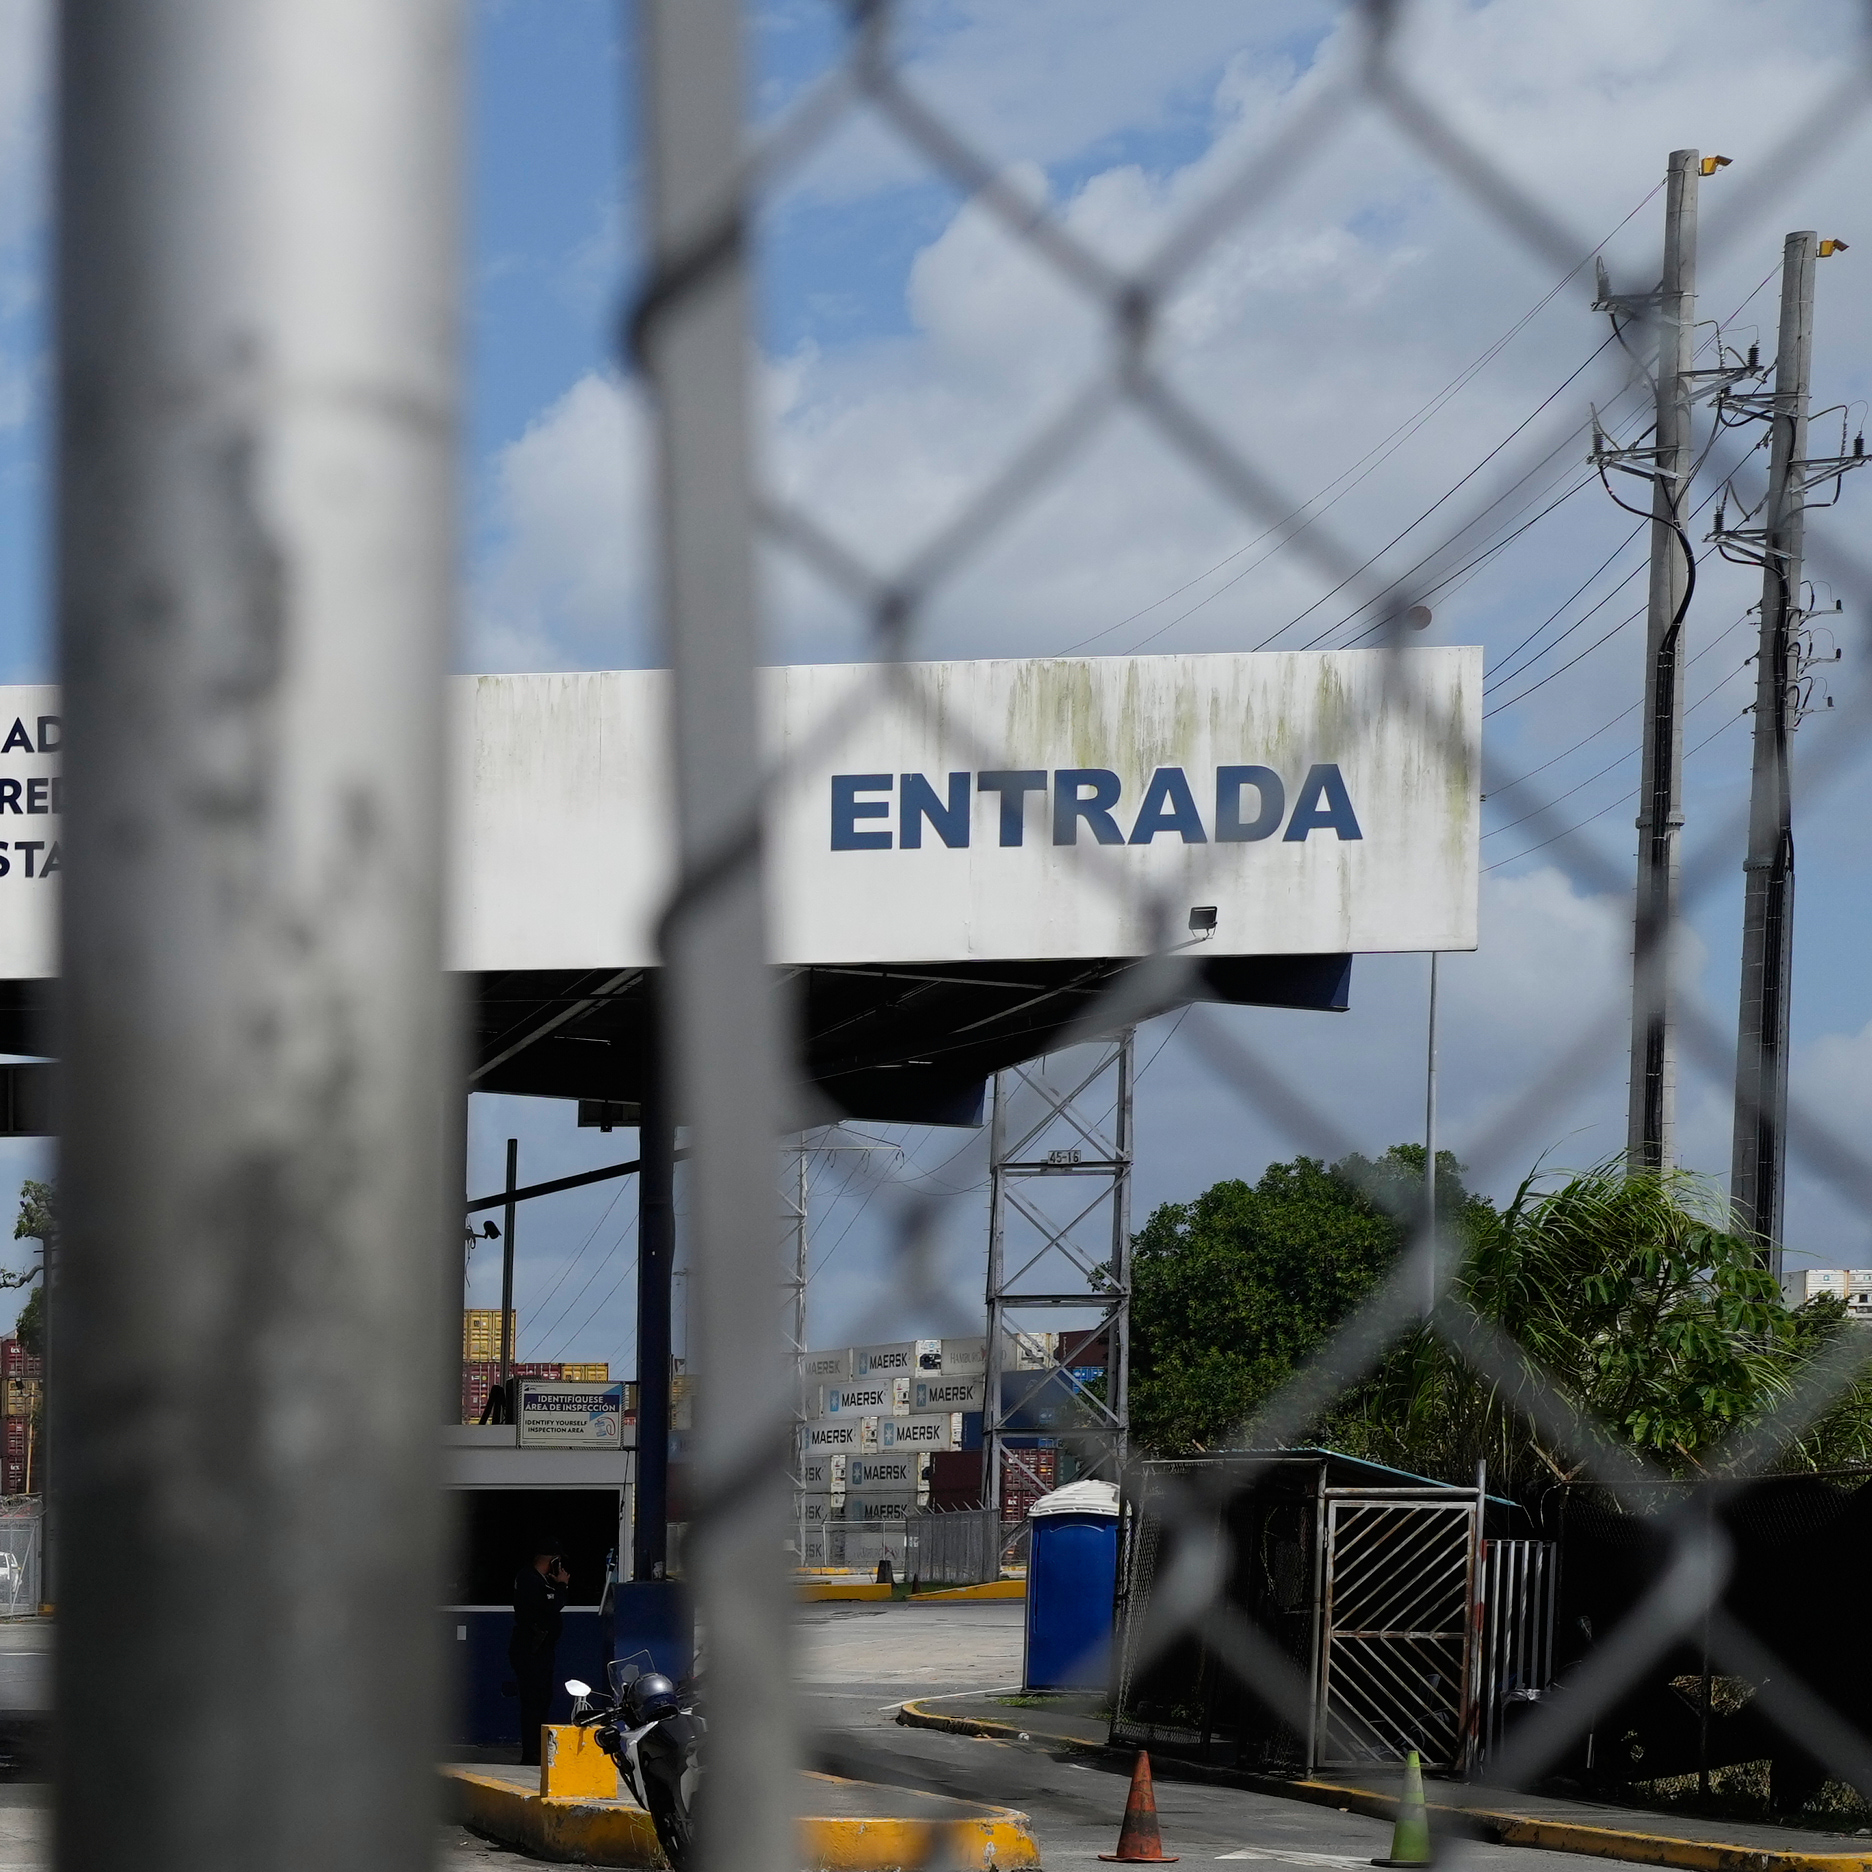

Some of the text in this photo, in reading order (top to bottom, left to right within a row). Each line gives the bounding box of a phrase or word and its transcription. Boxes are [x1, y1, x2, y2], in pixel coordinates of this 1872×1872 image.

[829, 763, 1364, 852] ENTRADA
[1049, 1151, 1079, 1163] 45-16
[869, 1352, 908, 1370] MAERSK
[841, 1390, 885, 1407] MAERSK
[929, 1385, 974, 1402] MAERSK
[525, 1401, 616, 1412] ÁREA DE INSPECCIÓN
[811, 1428, 854, 1445] MAERSK
[896, 1425, 941, 1441] MAERSK
[863, 1464, 907, 1480] MAERSK
